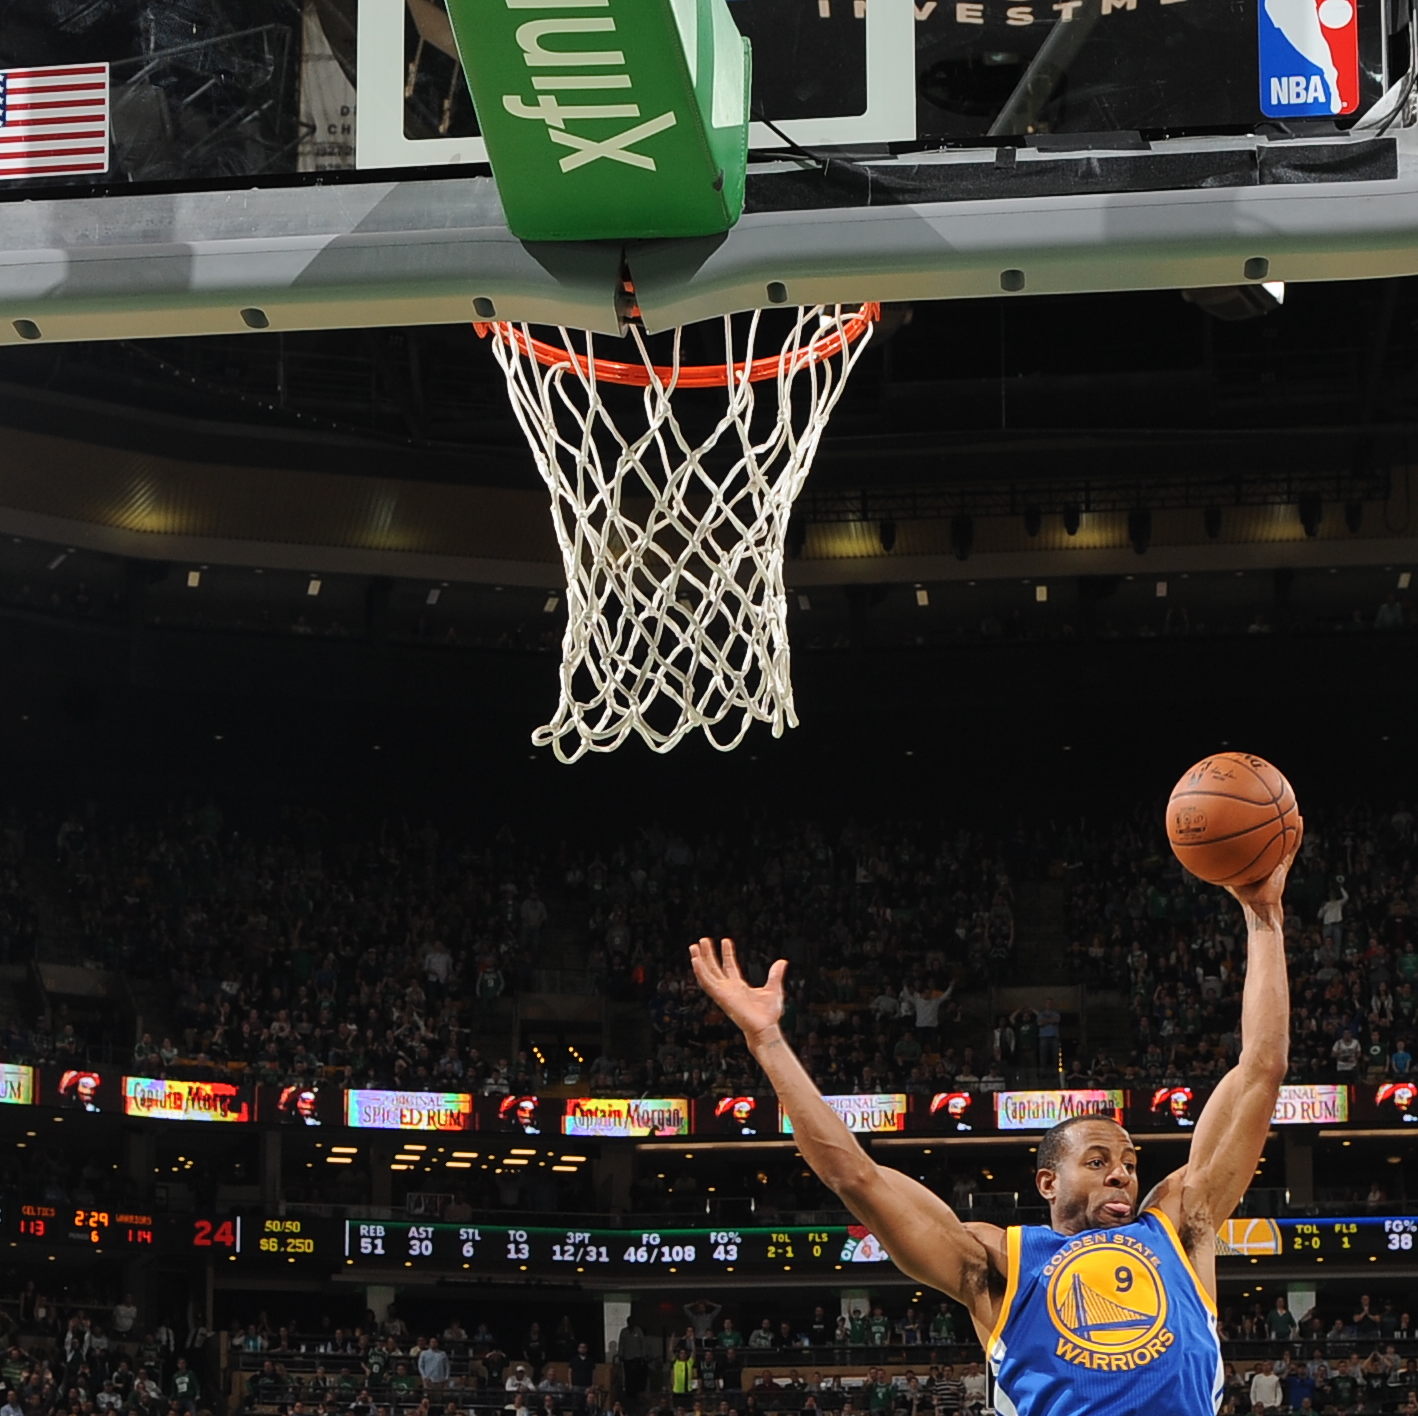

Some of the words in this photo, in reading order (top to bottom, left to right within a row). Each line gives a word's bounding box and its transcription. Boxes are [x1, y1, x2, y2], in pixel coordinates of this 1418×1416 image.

[1270, 75, 1326, 105] NBA
[1280, 1087, 1316, 1101] GINAL
[824, 1096, 878, 1109] RIGINAL
[1004, 1096, 1057, 1123] Captain
[362, 1105, 423, 1127] SPICED
[426, 1108, 463, 1128] RUM
[1301, 1100, 1337, 1121] RUM
[860, 1110, 897, 1130] RUM
[22, 1205, 56, 1217] CELTICS
[74, 1210, 109, 1228] 2:29
[264, 1219, 301, 1233] 50/50
[1384, 1219, 1418, 1233] FG%
[19, 1220, 45, 1237] 113
[193, 1219, 236, 1247] 24
[359, 1225, 385, 1237] REB
[408, 1227, 434, 1239] AST
[459, 1228, 481, 1241] STL
[1295, 1224, 1320, 1234] TOL
[1334, 1223, 1358, 1234] FLS
[90, 1230, 100, 1243] 6
[127, 1229, 152, 1244] 114
[507, 1230, 528, 1243] TO
[566, 1232, 591, 1245] 3PT
[642, 1233, 661, 1246] FG
[709, 1232, 742, 1244] FG%
[771, 1233, 791, 1243] TOL
[808, 1232, 828, 1243] FLS
[1293, 1237, 1321, 1250] 2-0
[1341, 1237, 1351, 1249] 1
[1387, 1233, 1413, 1250] 38
[359, 1238, 385, 1255] 51
[408, 1240, 433, 1256] 30
[462, 1242, 474, 1258] 6
[506, 1243, 530, 1260] 13
[712, 1244, 738, 1261] 43
[767, 1245, 794, 1258] 2-1
[812, 1245, 822, 1257] 0
[552, 1245, 610, 1263] 12/31
[623, 1245, 696, 1264] 46/108
[1042, 1233, 1108, 1277] GOLDEN
[1113, 1234, 1162, 1269] STATE
[1114, 1265, 1134, 1293] 9
[1055, 1327, 1175, 1372] WARRIORS
